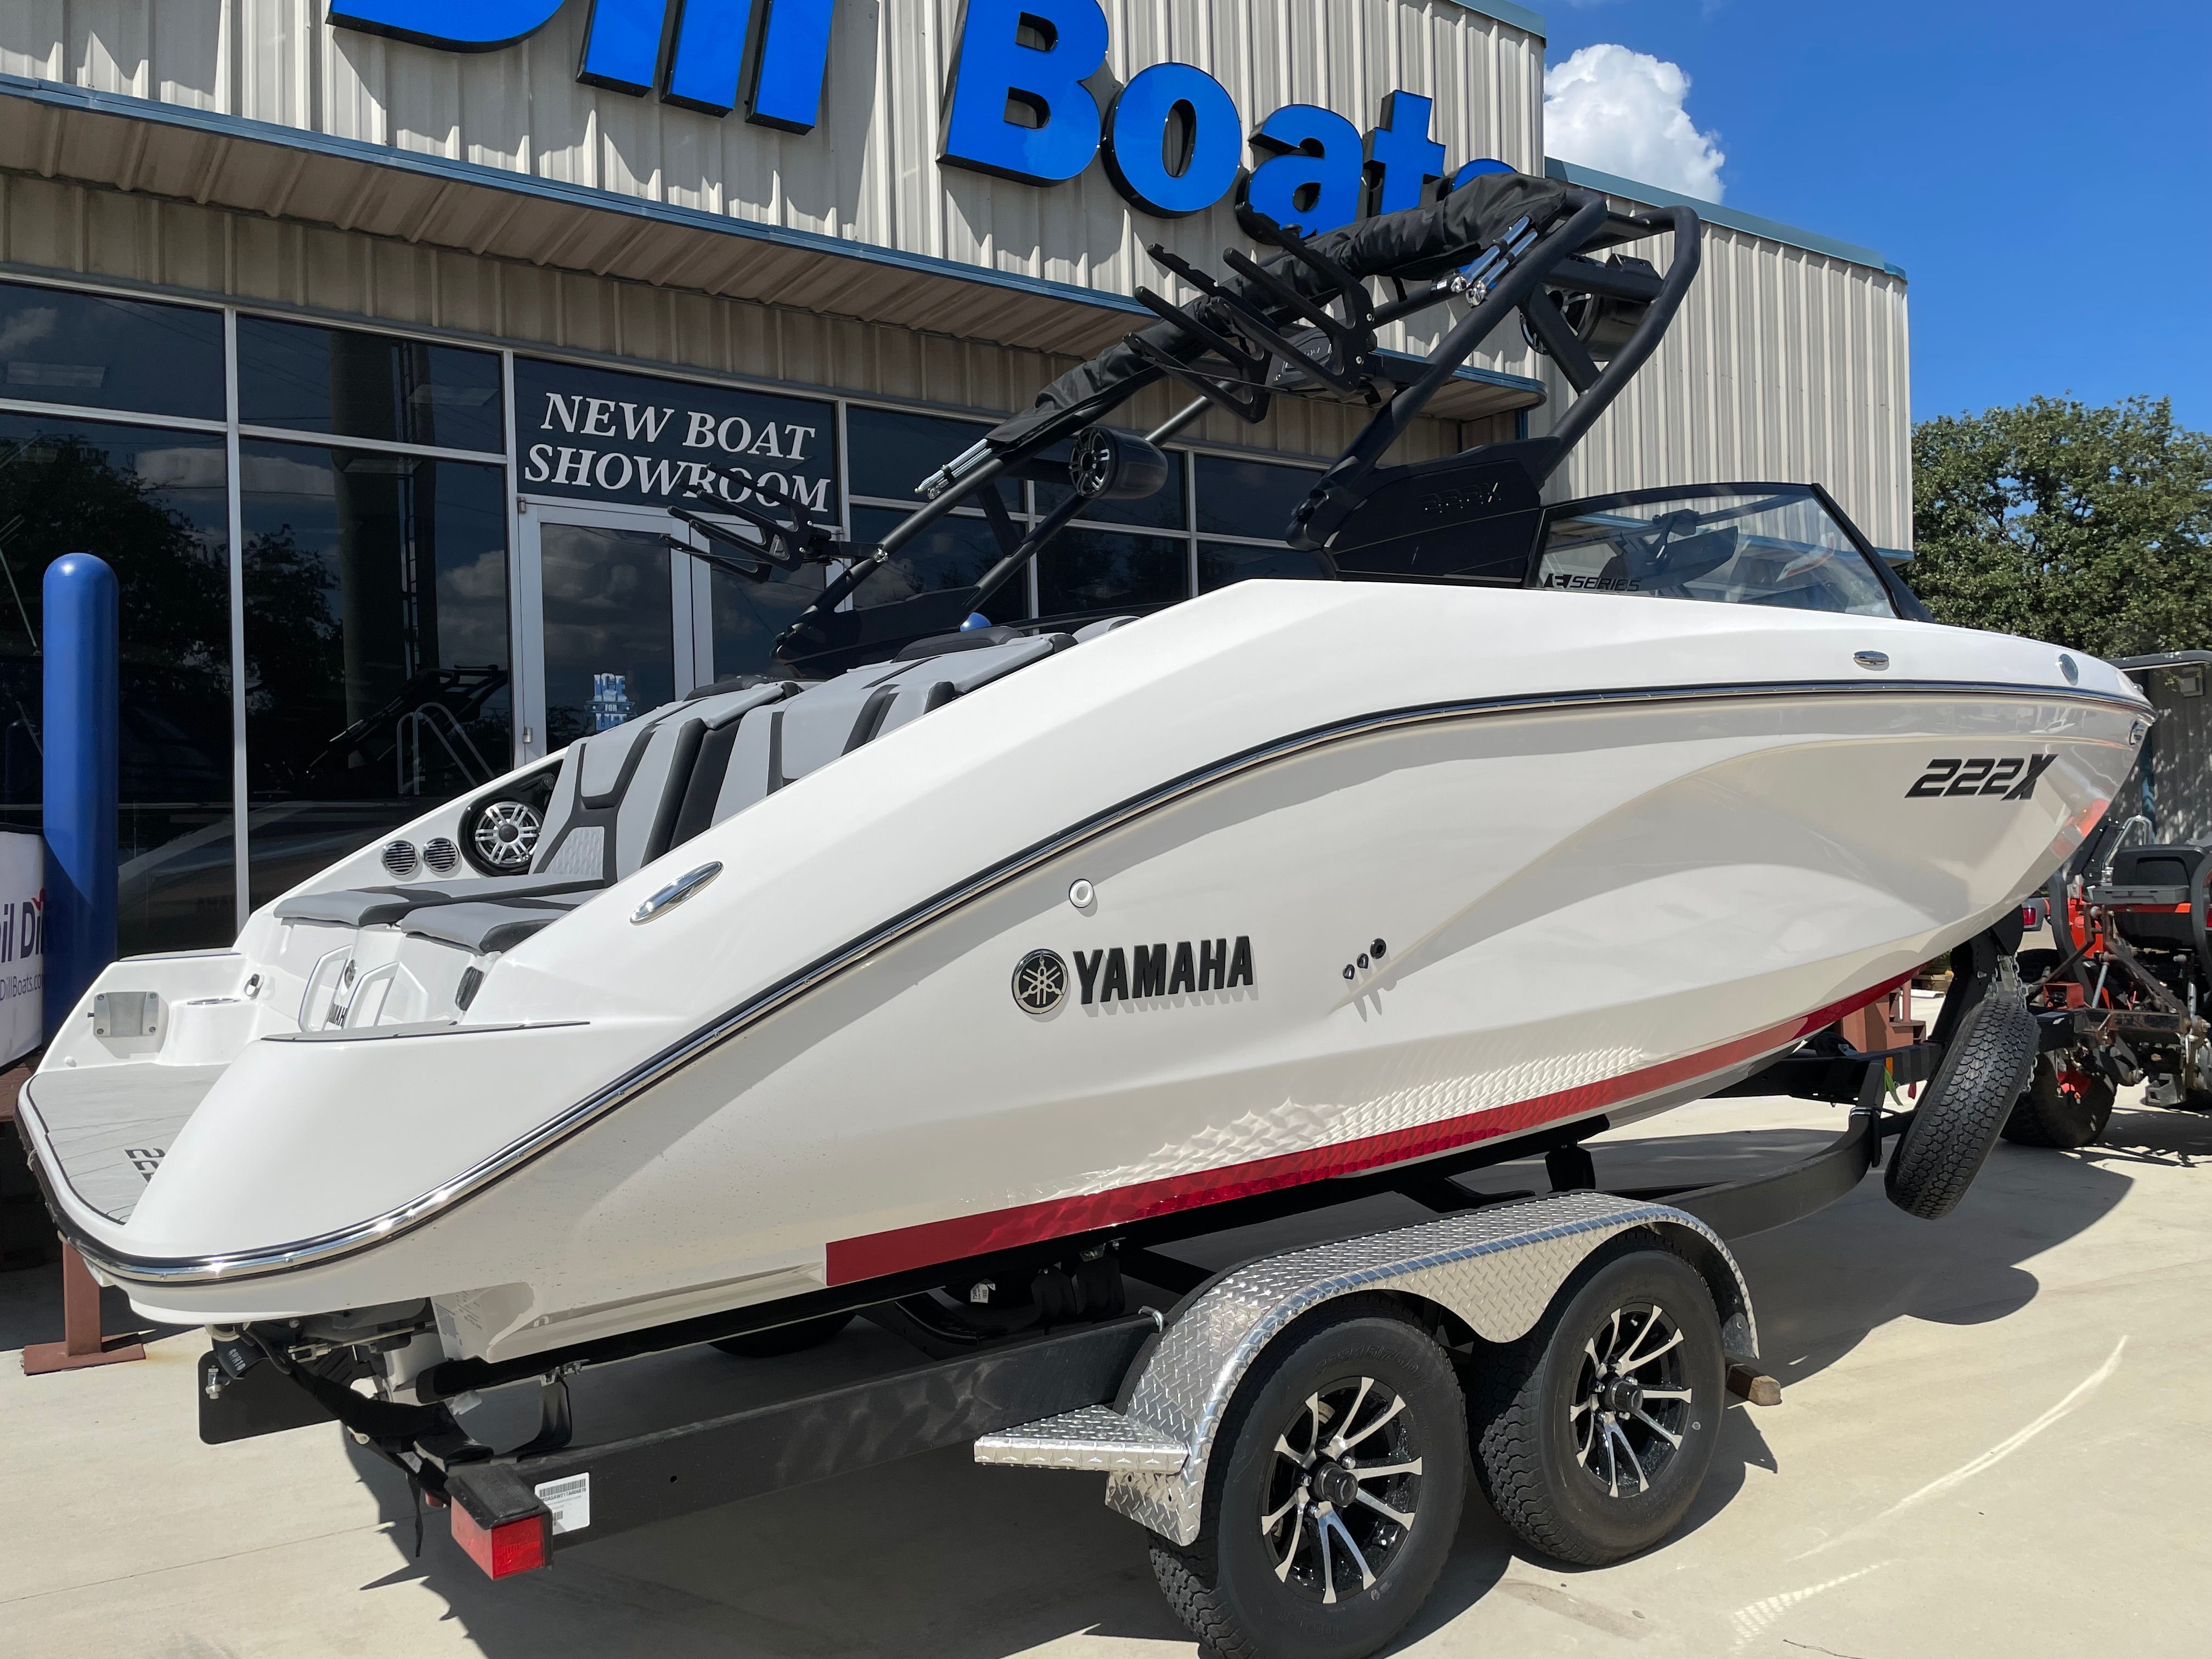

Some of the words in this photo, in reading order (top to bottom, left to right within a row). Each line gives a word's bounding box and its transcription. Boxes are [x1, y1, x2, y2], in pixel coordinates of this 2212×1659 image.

[936, 0, 1520, 242] Boat
[540, 392, 675, 443] NEW
[682, 411, 815, 460] BOAT
[524, 444, 831, 512] SHOWROOM
[1570, 576, 1641, 591] SERIES
[594, 673, 627, 702] ICE
[1905, 753, 2058, 801] 222X
[0, 902, 14, 963] il
[0, 974, 43, 1001] DillBoats.co
[1073, 935, 1254, 1005] YAMAHA
